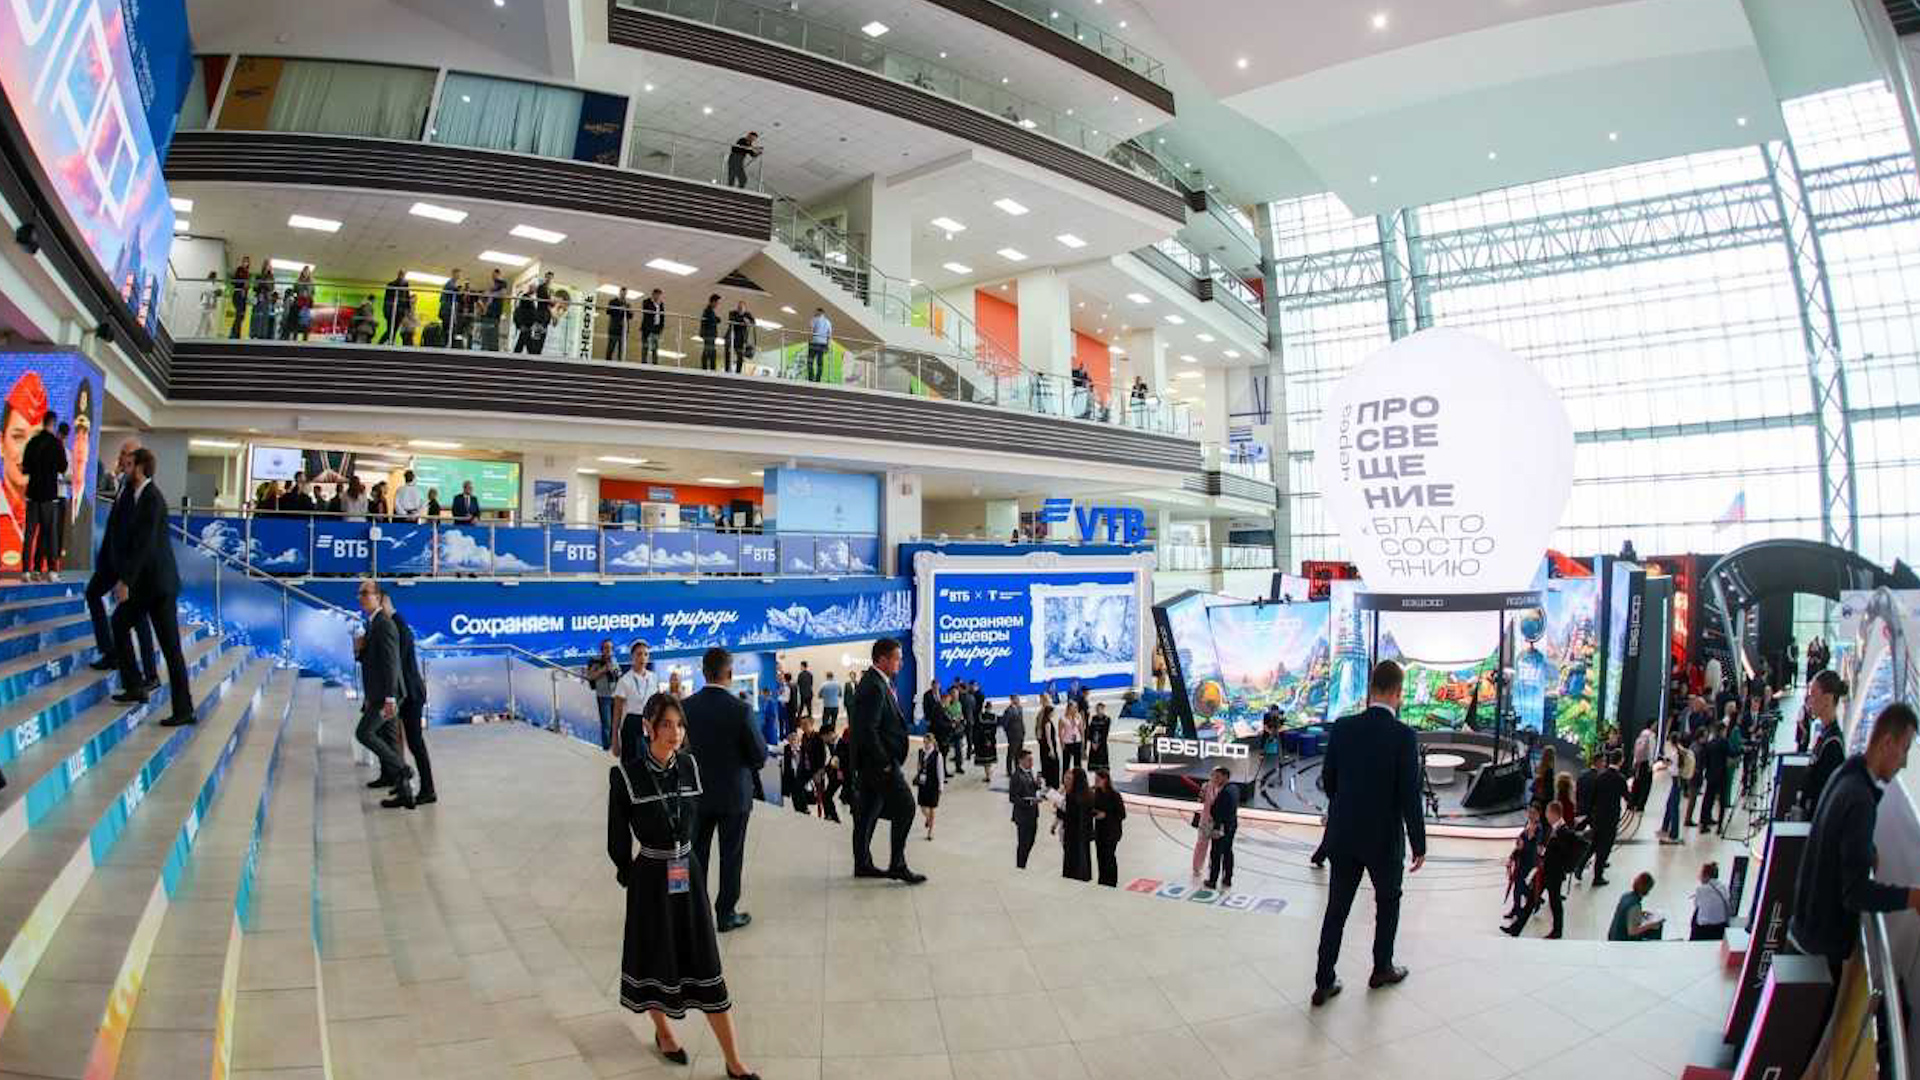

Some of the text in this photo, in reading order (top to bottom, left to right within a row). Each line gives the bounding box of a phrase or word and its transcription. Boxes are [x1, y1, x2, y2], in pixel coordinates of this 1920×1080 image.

[1357, 396, 1440, 425] ПРО
[1356, 424, 1439, 452] СВЕ
[1358, 454, 1426, 480] ЩЕ
[1364, 484, 1454, 509] НИЕ
[1075, 506, 1144, 543] VTB
[1373, 514, 1485, 535] БЛАГО
[333, 540, 368, 558] ВТБ
[567, 544, 597, 561] ВТБ
[754, 547, 776, 562] ВТБ
[1381, 537, 1495, 556] СОСТО
[1387, 558, 1480, 577] ЯНИЮ
[949, 591, 971, 602] ВТБ
[451, 607, 739, 638] Сохраняем шедевры природы
[940, 614, 1024, 631] Сохраняем
[940, 630, 1010, 645] шедевры
[940, 645, 1013, 667] природы
